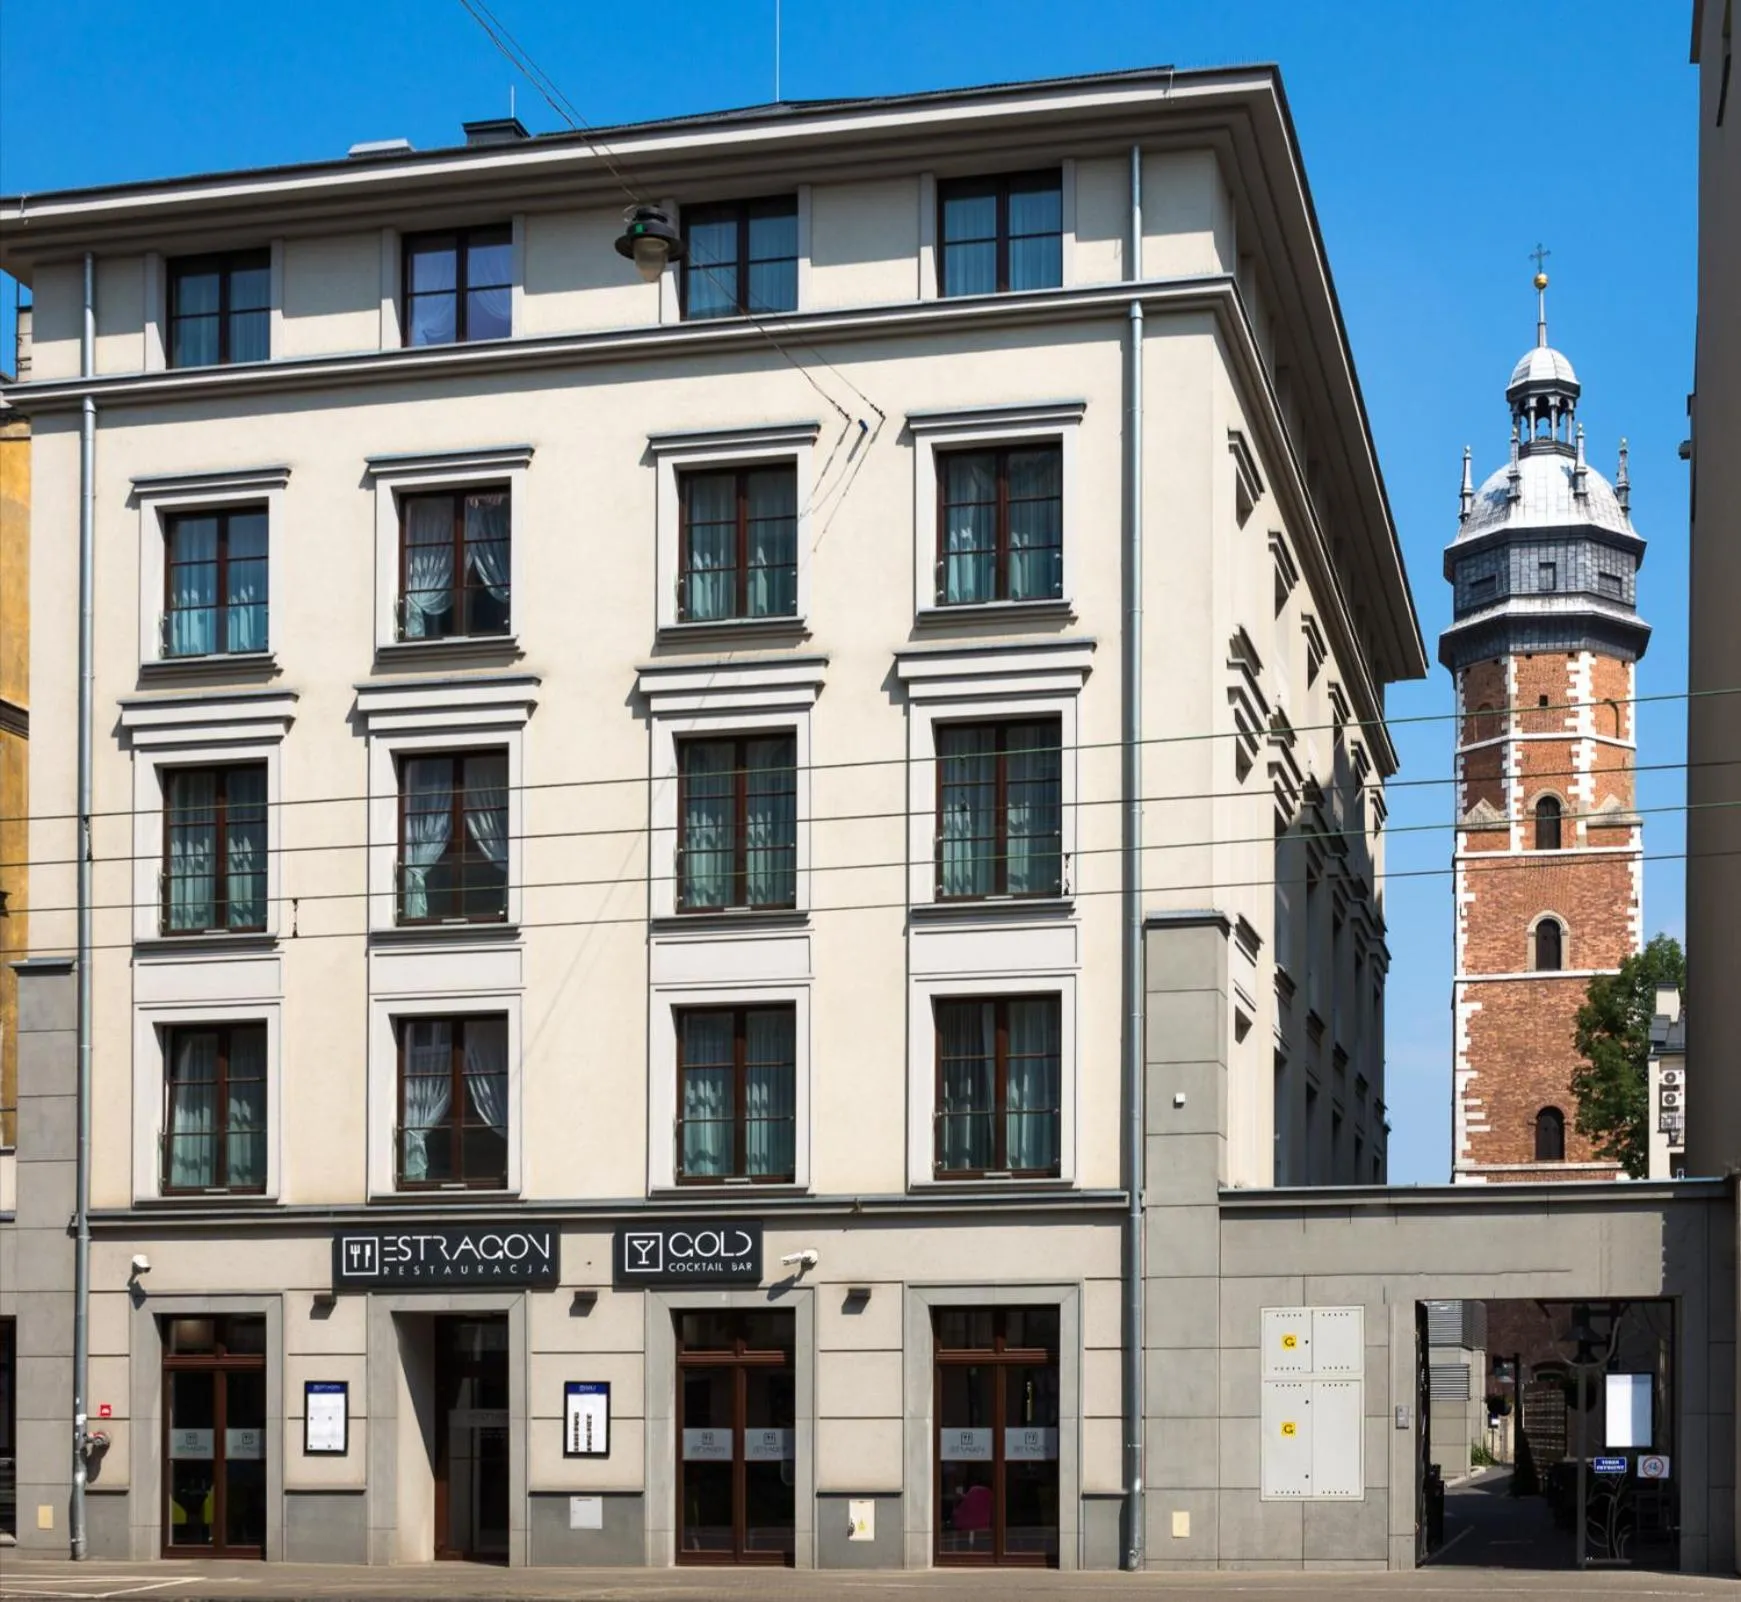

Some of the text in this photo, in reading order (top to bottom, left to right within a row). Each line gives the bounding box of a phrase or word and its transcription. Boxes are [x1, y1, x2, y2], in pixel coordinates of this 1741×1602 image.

[383, 1233, 550, 1262] ESTRAGON
[668, 1231, 753, 1257] GOLD
[383, 1264, 550, 1276] RESTAURACJA
[668, 1262, 753, 1272] COCKTAIL BAR
